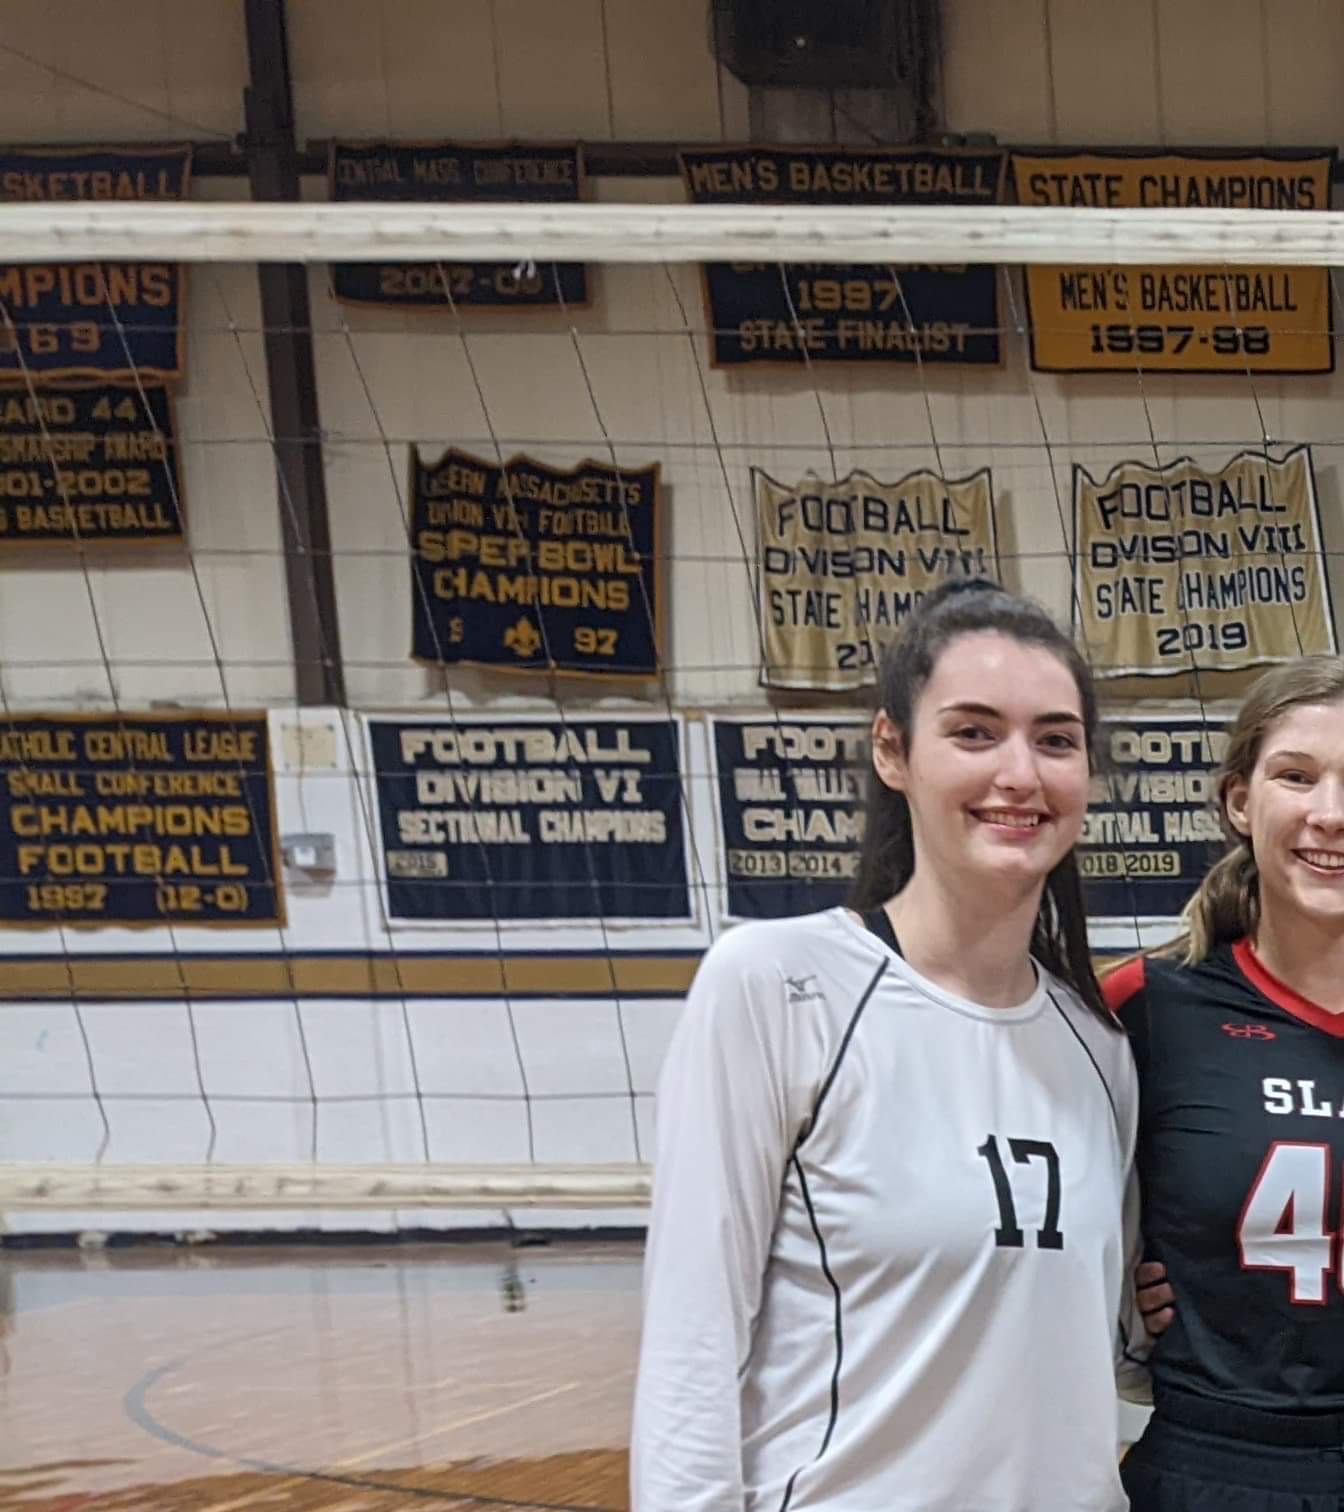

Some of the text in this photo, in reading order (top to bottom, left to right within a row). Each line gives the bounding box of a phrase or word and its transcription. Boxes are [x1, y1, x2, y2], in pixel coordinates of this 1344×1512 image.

[691, 160, 992, 195] MEN'S BASKETBALL
[1030, 174, 1317, 209] STATE CHAMPIONS
[799, 280, 898, 311] 1997
[1060, 272, 1298, 312] MEN'S BASKETBALL
[740, 319, 971, 353] STATE FINALIST
[1091, 324, 1271, 354] 1997-98
[1097, 474, 1286, 530] FOOTBALL
[1239, 524, 1306, 553] VIII
[538, 540, 642, 574] BOWL
[1157, 621, 1247, 656] 2019
[84, 731, 175, 761] CENTRAL
[184, 731, 257, 761] LEAGUE
[400, 728, 651, 764] FOOTBALL
[742, 726, 871, 761] FOOT
[8, 770, 242, 797] SMALL CONFERENCE
[416, 769, 642, 804] DIVISION VI
[10, 805, 250, 836] CHAMPIONS
[398, 810, 667, 844] SECTIONAL CHAMPIONS
[17, 844, 249, 876] FOOTBALL
[1082, 854, 1174, 873] 018 2019
[977, 1133, 1064, 1251] 17
